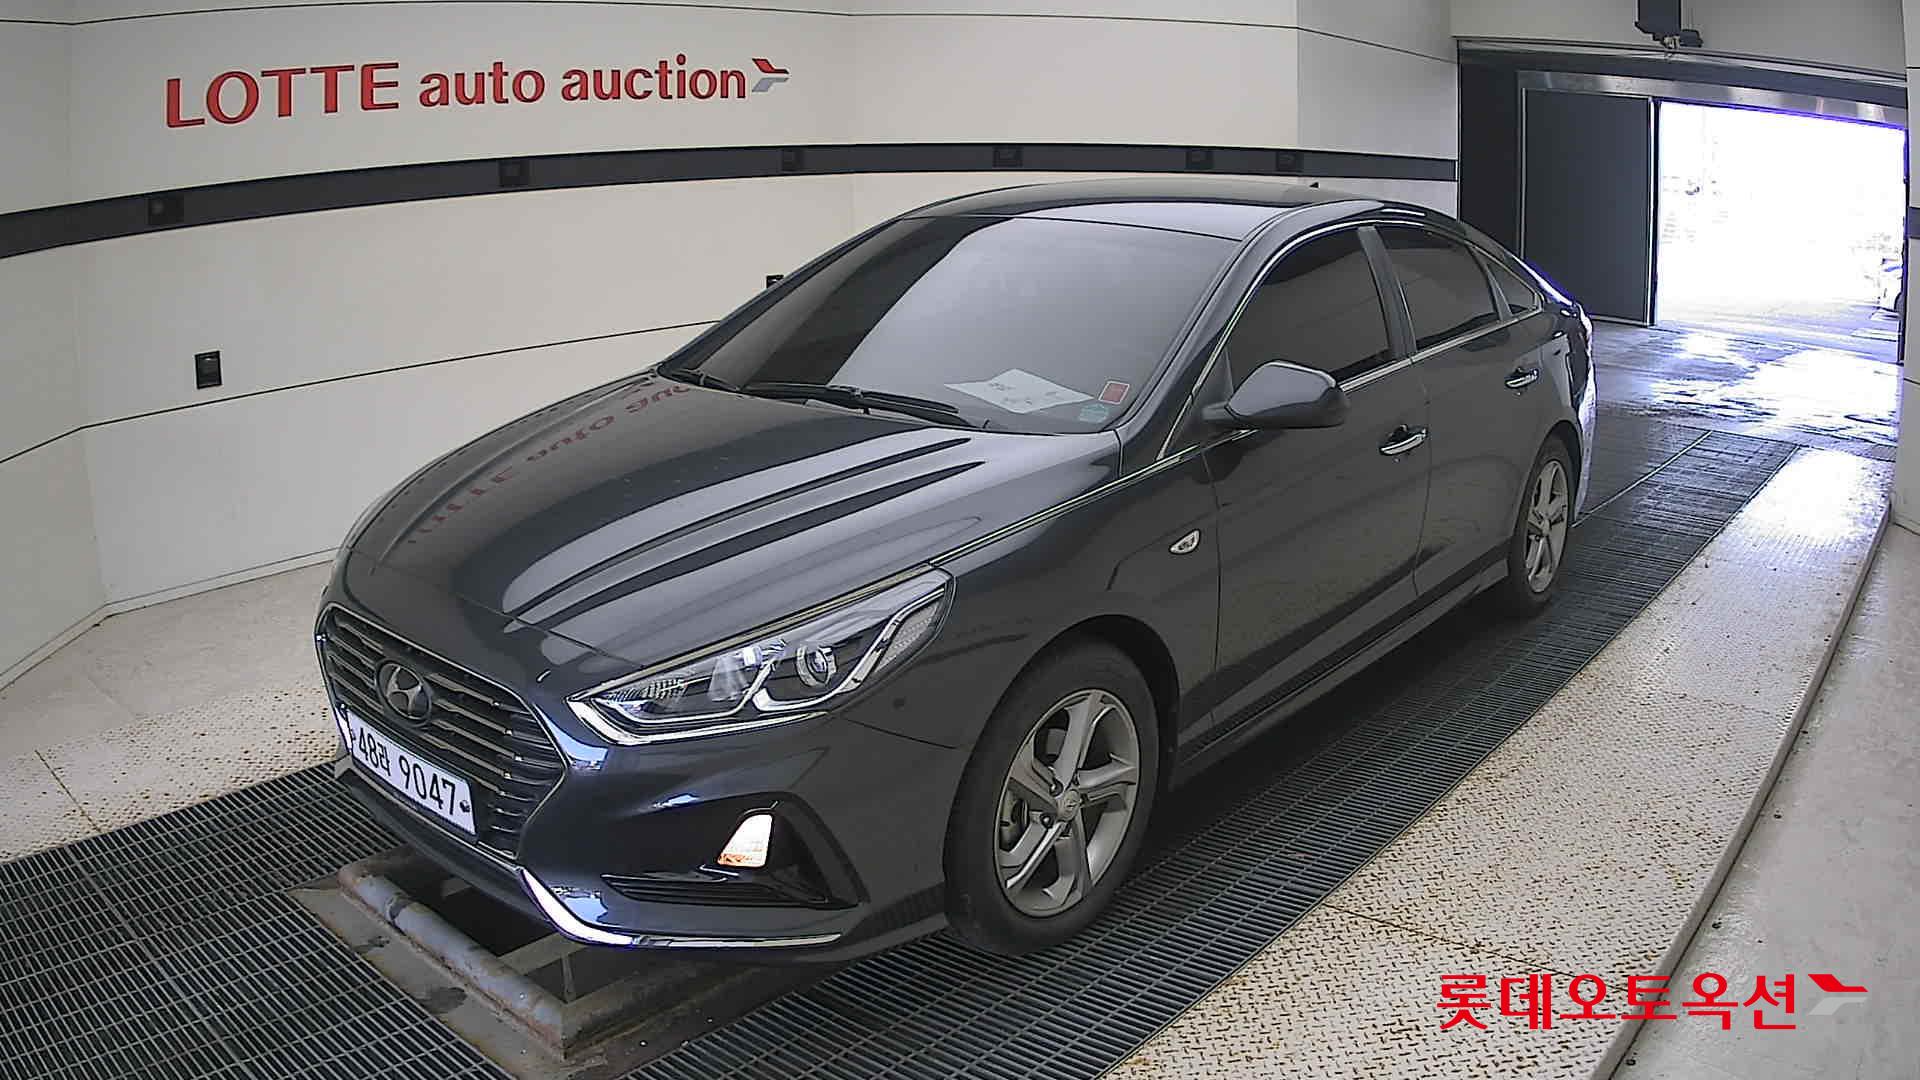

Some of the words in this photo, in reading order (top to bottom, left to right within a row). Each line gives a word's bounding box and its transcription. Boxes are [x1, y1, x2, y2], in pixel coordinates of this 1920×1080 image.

[166, 62, 400, 128] LOTTE
[419, 61, 546, 108] auto
[561, 53, 747, 101] auction
[398, 755, 456, 815] 9047
